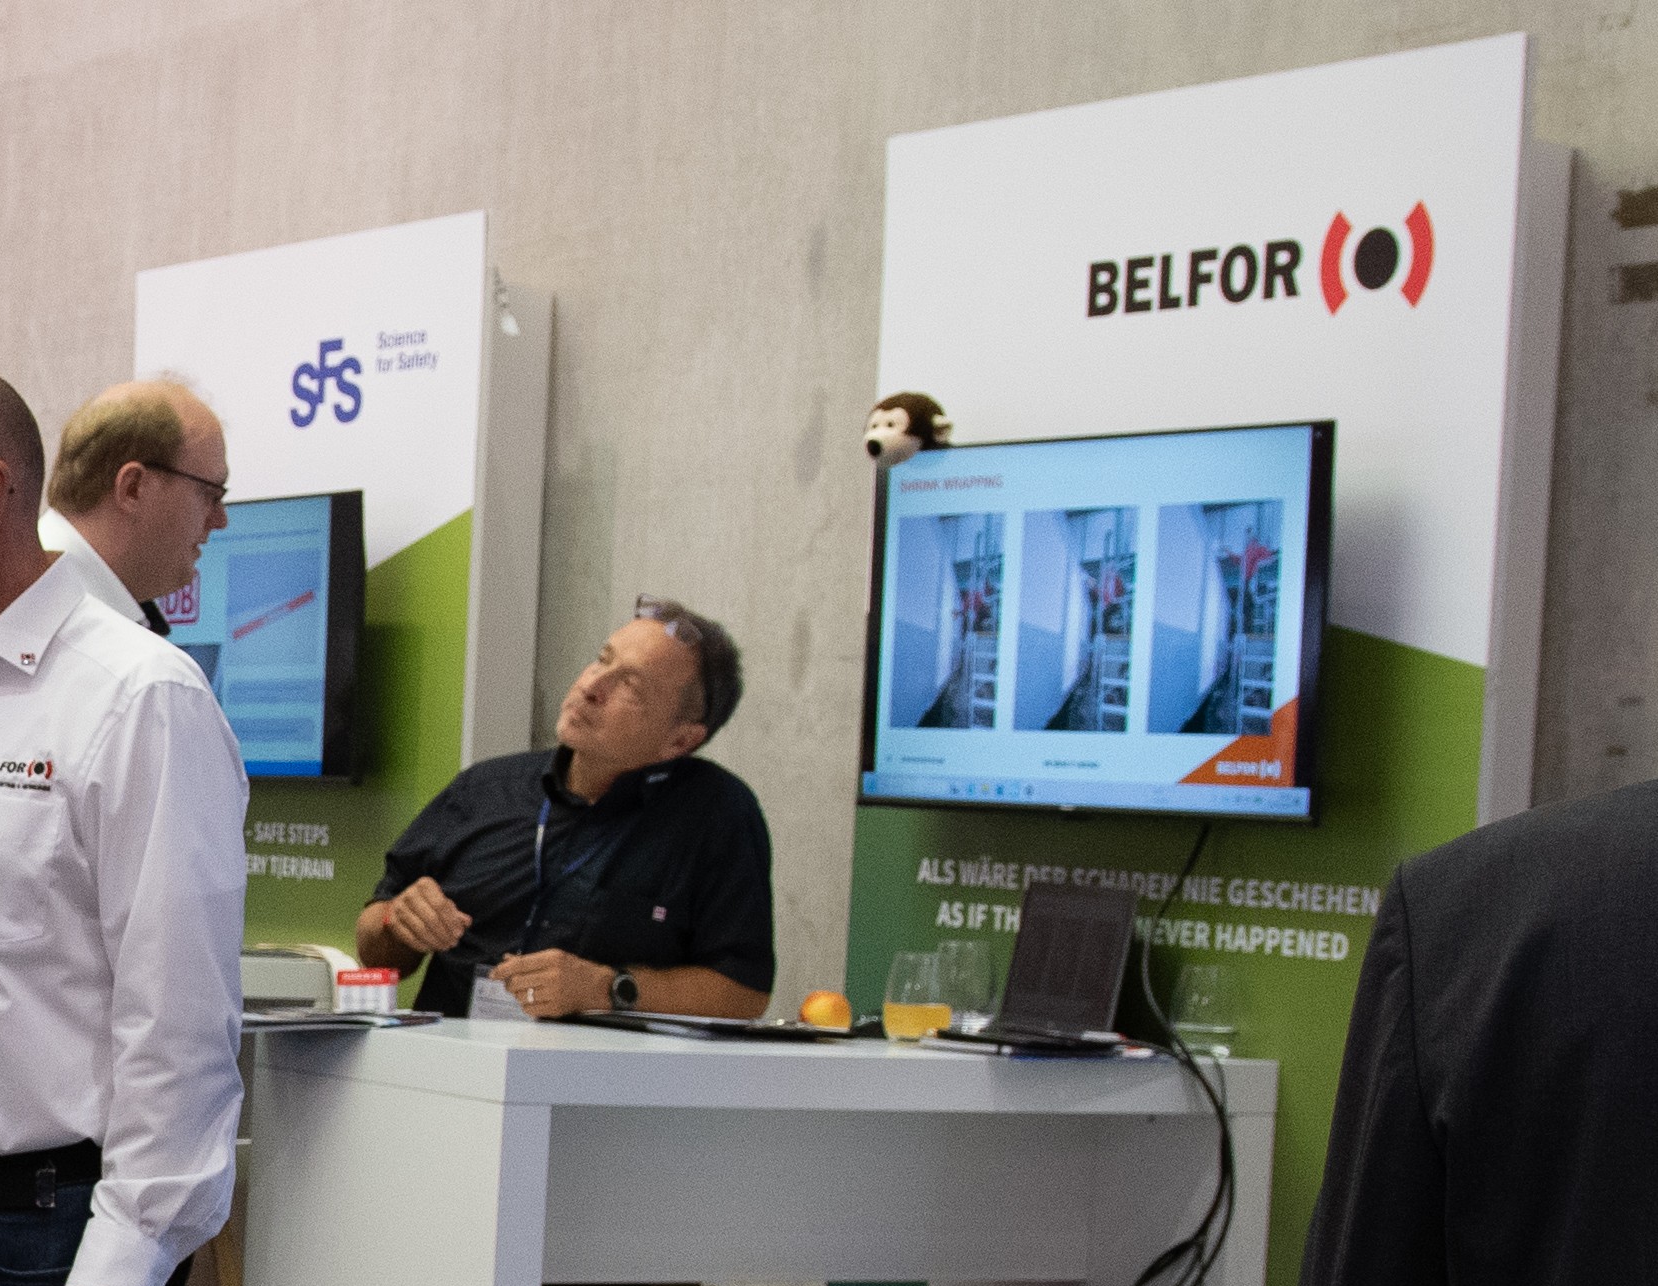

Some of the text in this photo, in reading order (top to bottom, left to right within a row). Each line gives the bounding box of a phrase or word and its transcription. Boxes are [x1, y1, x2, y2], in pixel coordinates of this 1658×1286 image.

[1087, 239, 1302, 317] BELFOR
[377, 330, 427, 350] Science
[377, 351, 439, 373] for Safety
[255, 822, 285, 843] SAFE
[288, 823, 329, 846] STEPS
[246, 852, 267, 875] ERY
[917, 858, 956, 885] ALS
[960, 856, 1019, 890] WÄRE
[1184, 875, 1222, 904] NIE
[1227, 878, 1381, 916] GESCHEHEN
[937, 901, 965, 928] AS
[968, 903, 988, 930] IF
[992, 905, 1021, 933] TH
[1215, 923, 1349, 961] HAPPENED
